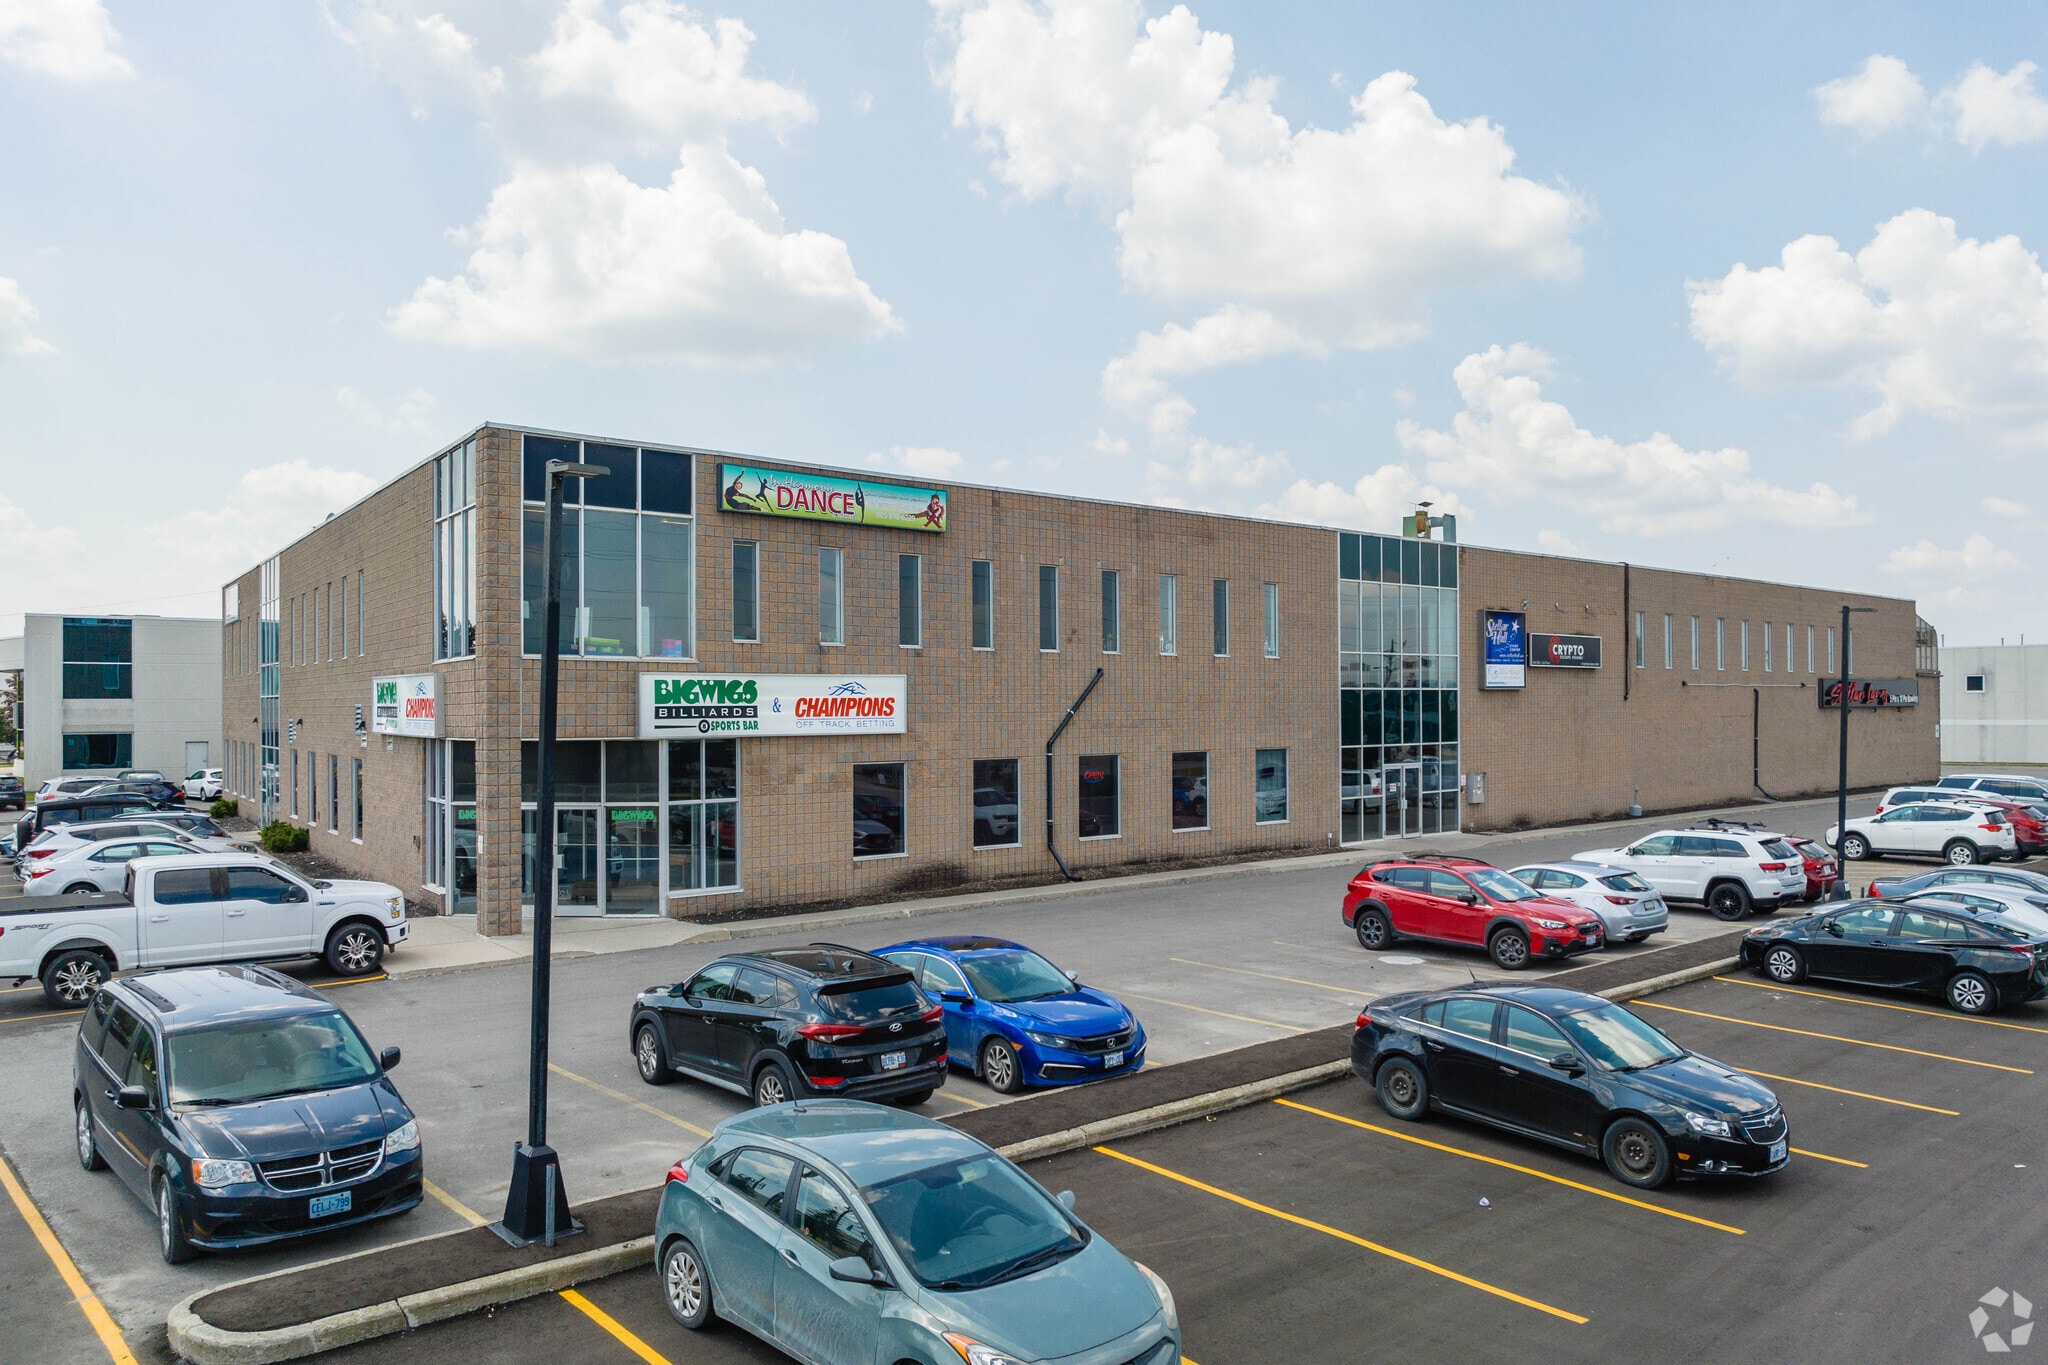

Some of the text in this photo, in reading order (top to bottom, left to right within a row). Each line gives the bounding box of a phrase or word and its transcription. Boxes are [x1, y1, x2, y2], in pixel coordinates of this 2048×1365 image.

[777, 485, 855, 515] DANCE
[1552, 644, 1585, 656] CRYPTO
[654, 679, 758, 705] BIGWIGS
[405, 698, 435, 719] CHAMPIONS
[659, 708, 755, 717] BILLIARDS
[772, 697, 896, 718] & CHAMPIONS
[711, 720, 740, 731] SPORTS
[743, 720, 759, 730] BAR
[796, 719, 895, 728] OFF TRACK BETTING
[1084, 770, 1104, 780] OPEN
[10, 923, 54, 931] SPORT
